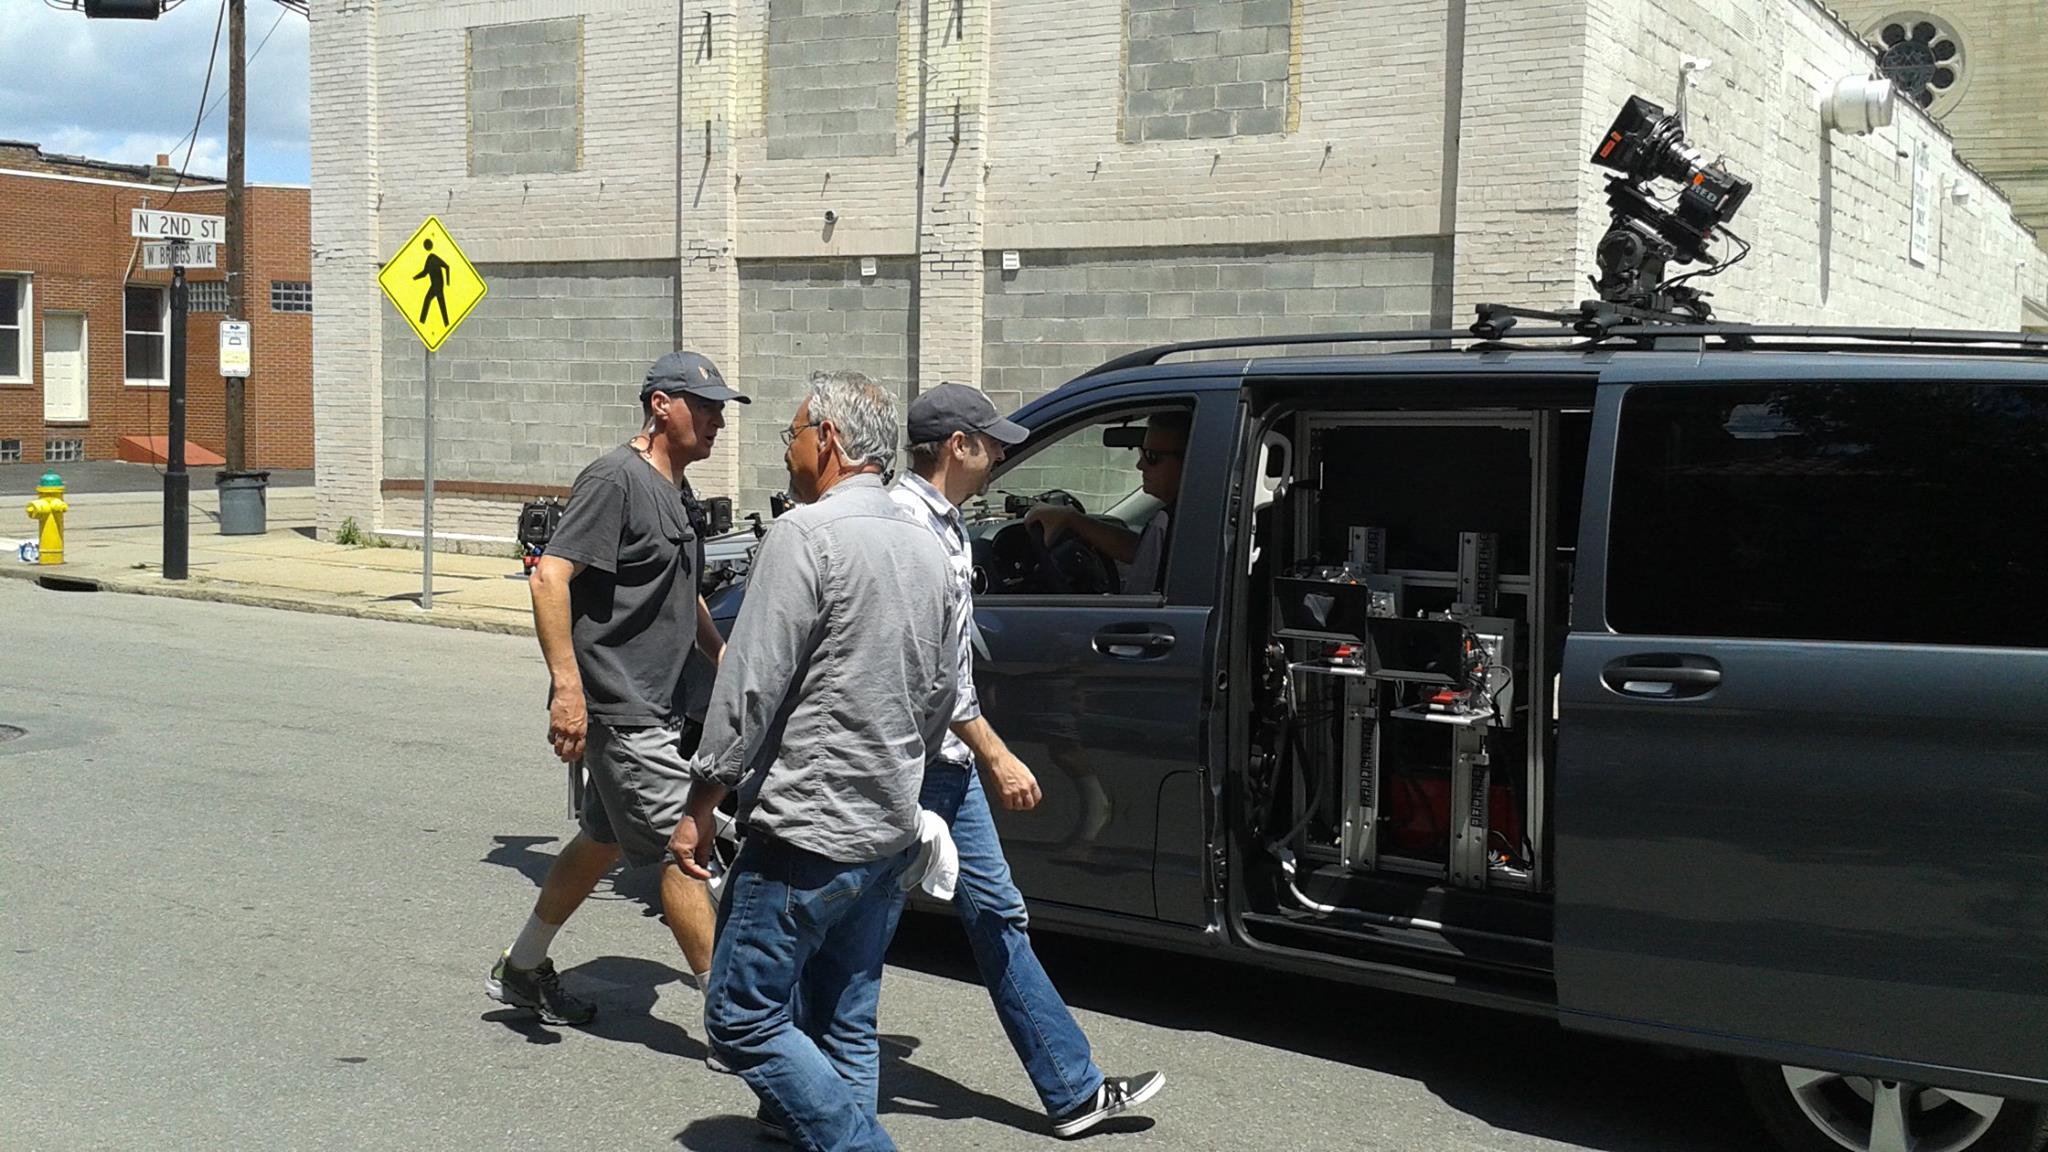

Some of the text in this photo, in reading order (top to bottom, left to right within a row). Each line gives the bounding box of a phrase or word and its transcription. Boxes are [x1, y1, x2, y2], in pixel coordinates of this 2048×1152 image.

[1690, 184, 1717, 203] RED
[139, 214, 218, 239] N 2ND ST
[146, 244, 212, 265] W BRIGGS AVE
